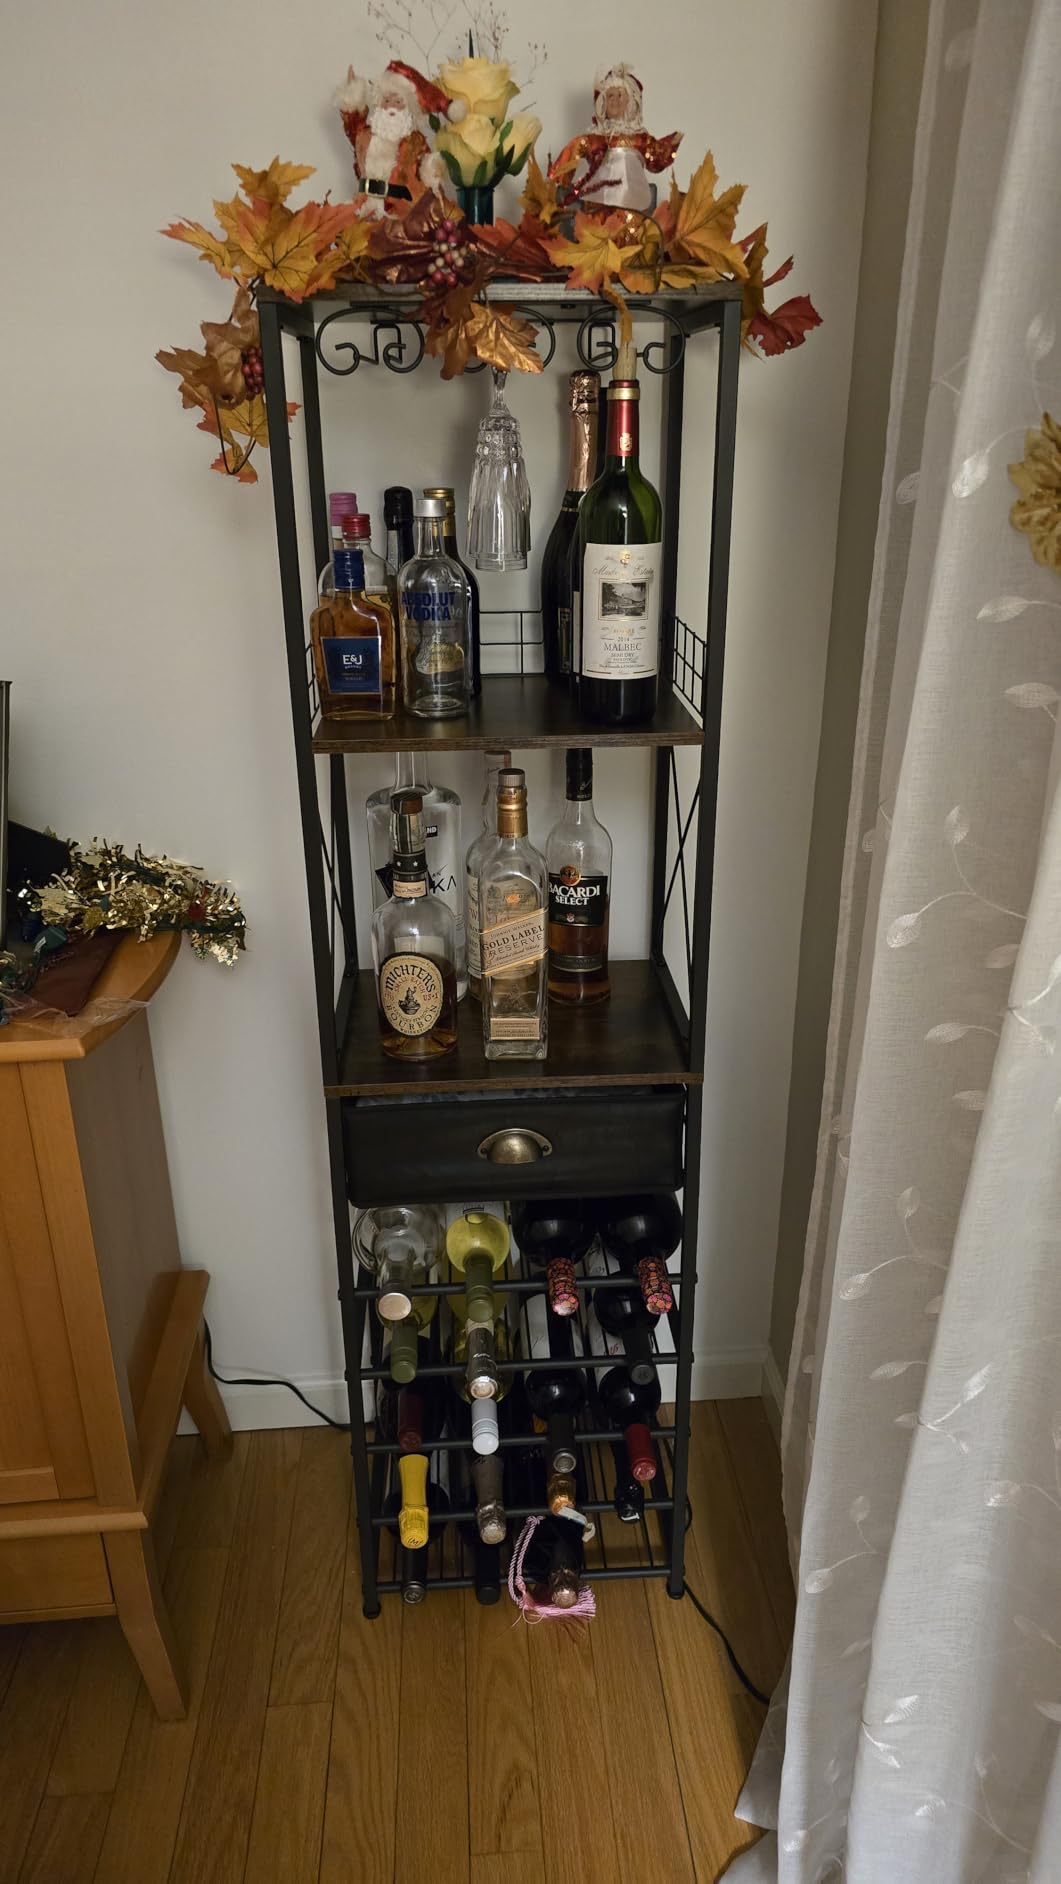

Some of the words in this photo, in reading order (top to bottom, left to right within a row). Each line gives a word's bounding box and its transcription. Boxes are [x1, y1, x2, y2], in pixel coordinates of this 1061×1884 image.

[401, 592, 456, 606] ABSOLUT
[405, 607, 451, 621] VODKA
[604, 642, 642, 652] MALBEC
[342, 654, 363, 665] E&J
[555, 895, 589, 906] SELECT
[482, 936, 509, 952] GOLD
[511, 924, 545, 941] LABEL
[488, 934, 543, 958] RESERVE
[386, 964, 436, 993] MICHTER'S
[386, 1004, 438, 1030] BOURBON
